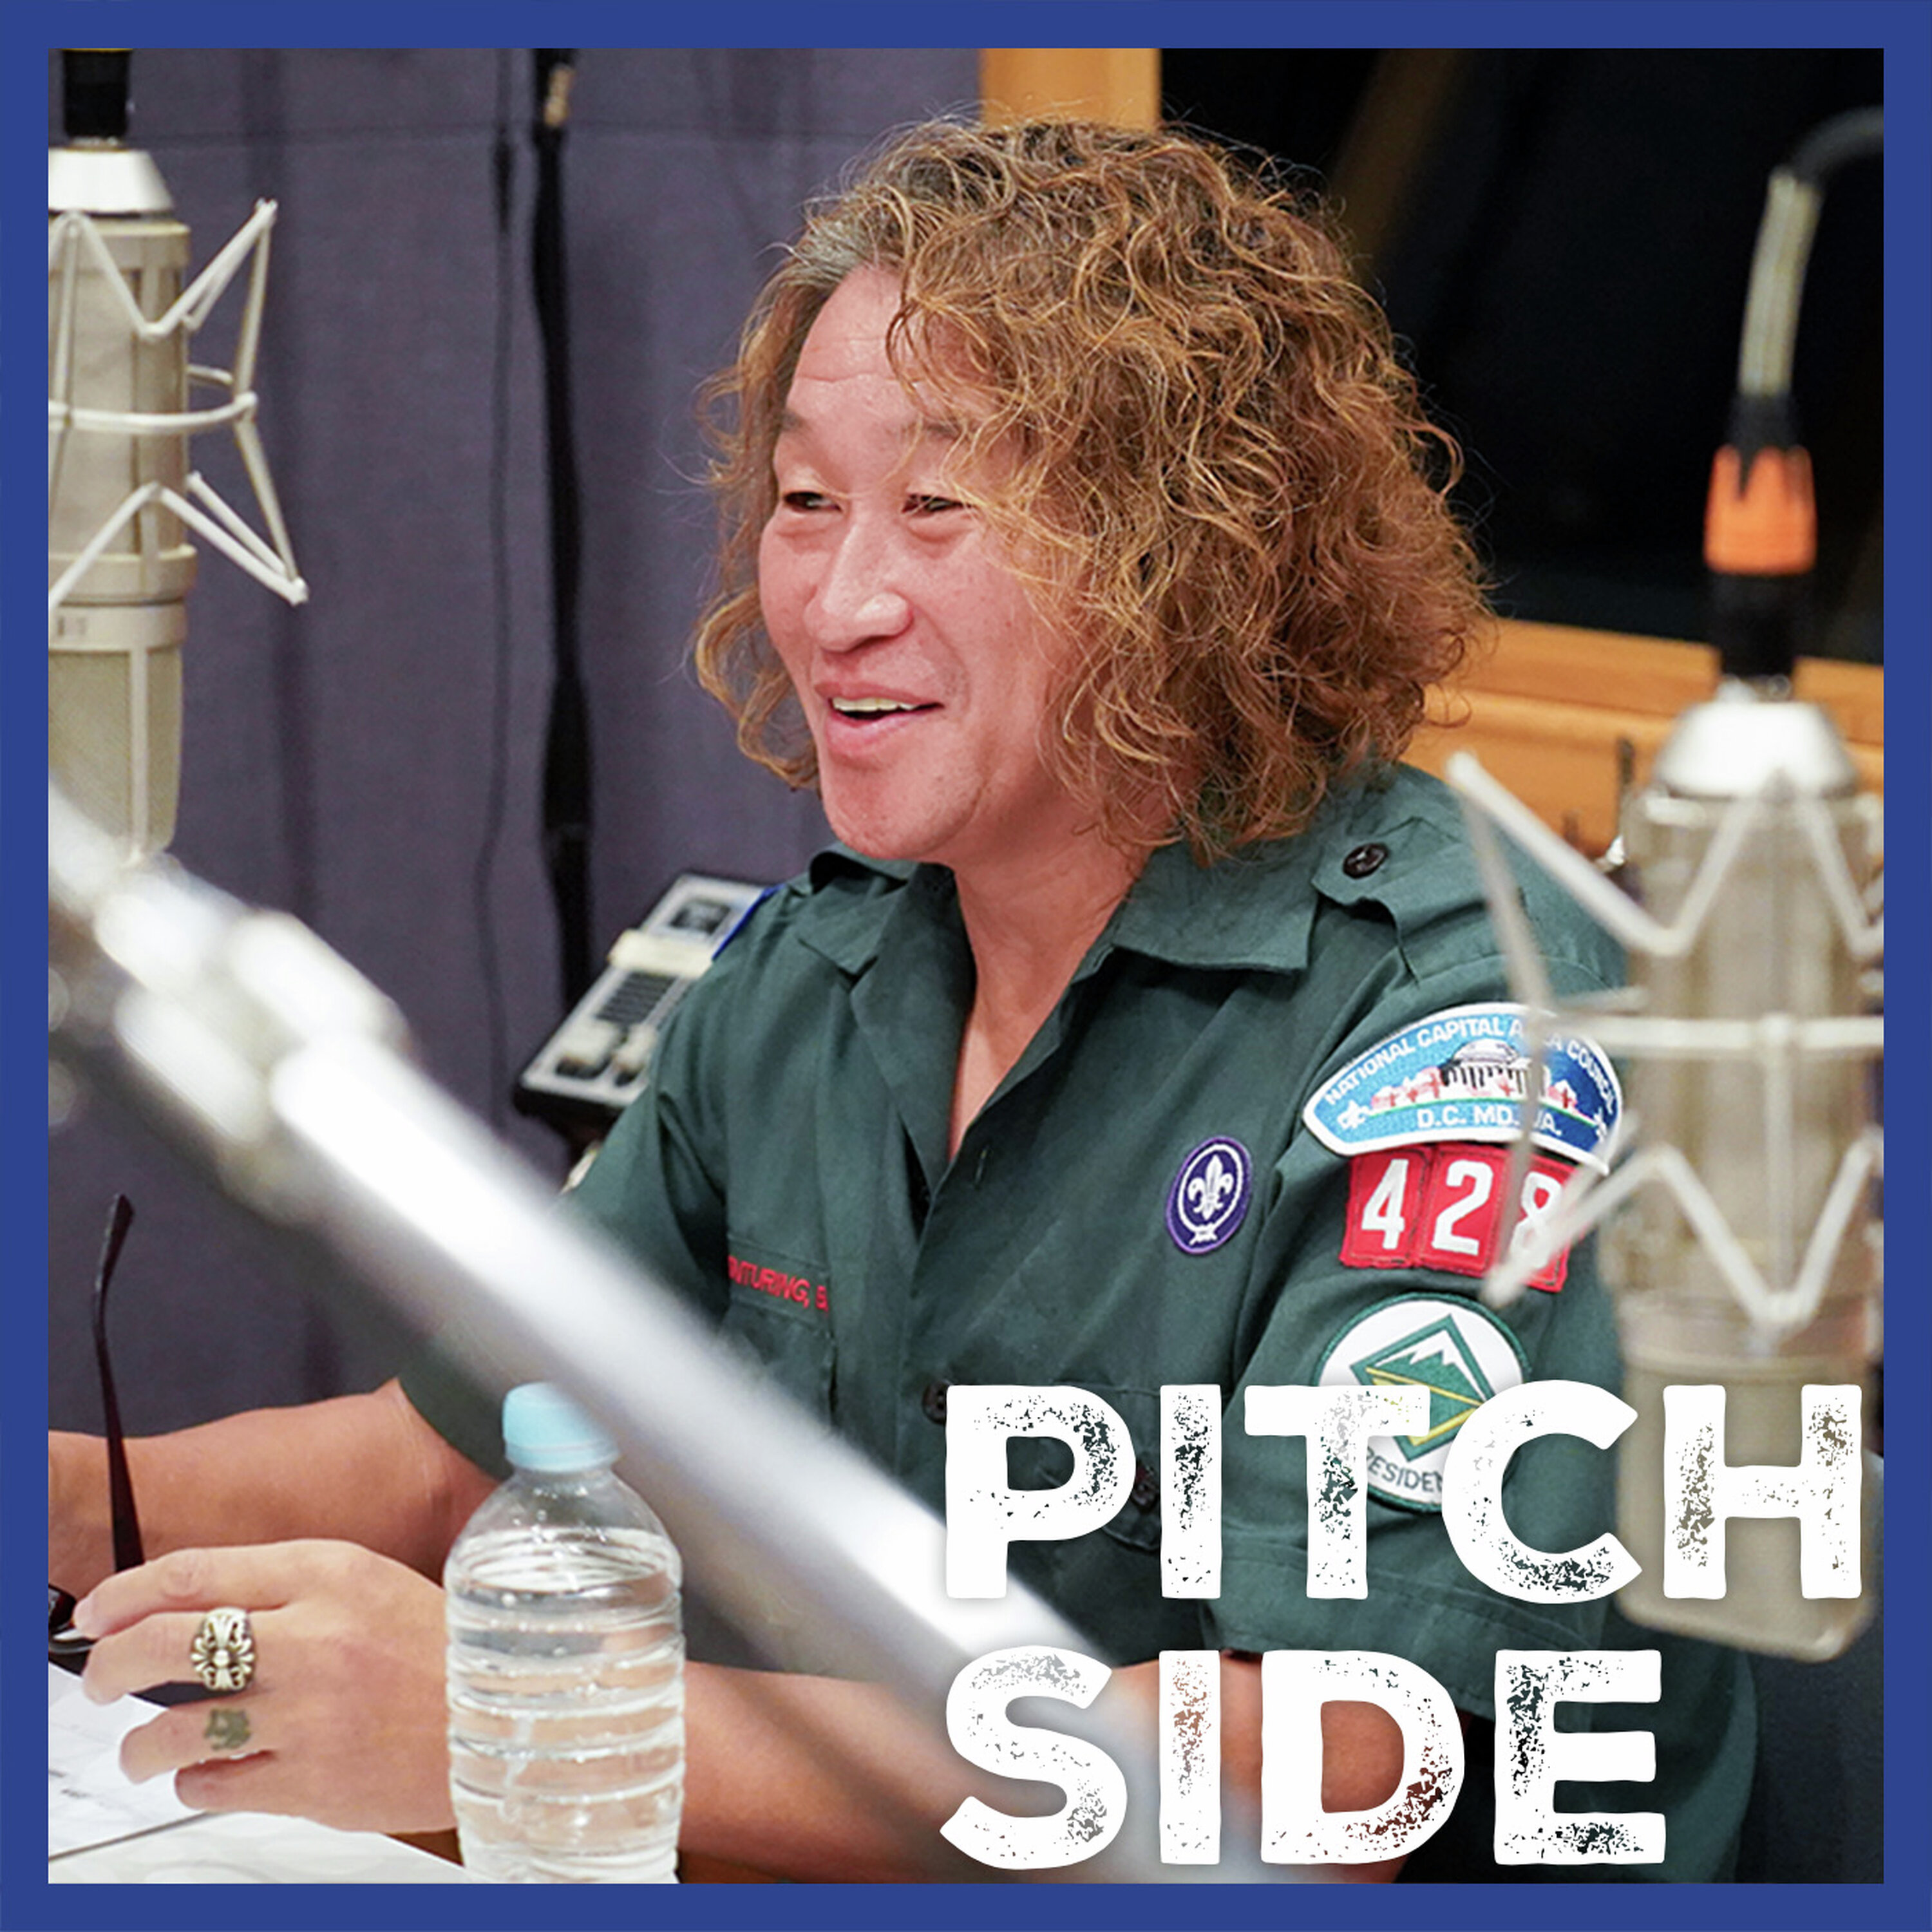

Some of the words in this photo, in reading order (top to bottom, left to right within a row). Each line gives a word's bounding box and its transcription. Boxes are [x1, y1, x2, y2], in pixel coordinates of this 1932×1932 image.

[1325, 1038, 1416, 1105] NATIONAL
[1417, 1017, 1506, 1047] CAPITAL
[1507, 1018, 1563, 1052] AA
[1417, 1107, 1468, 1128] D.C.
[1473, 1105, 1520, 1126] MD.
[1361, 1159, 1563, 1271] 428
[728, 1255, 811, 1309] NTURING,
